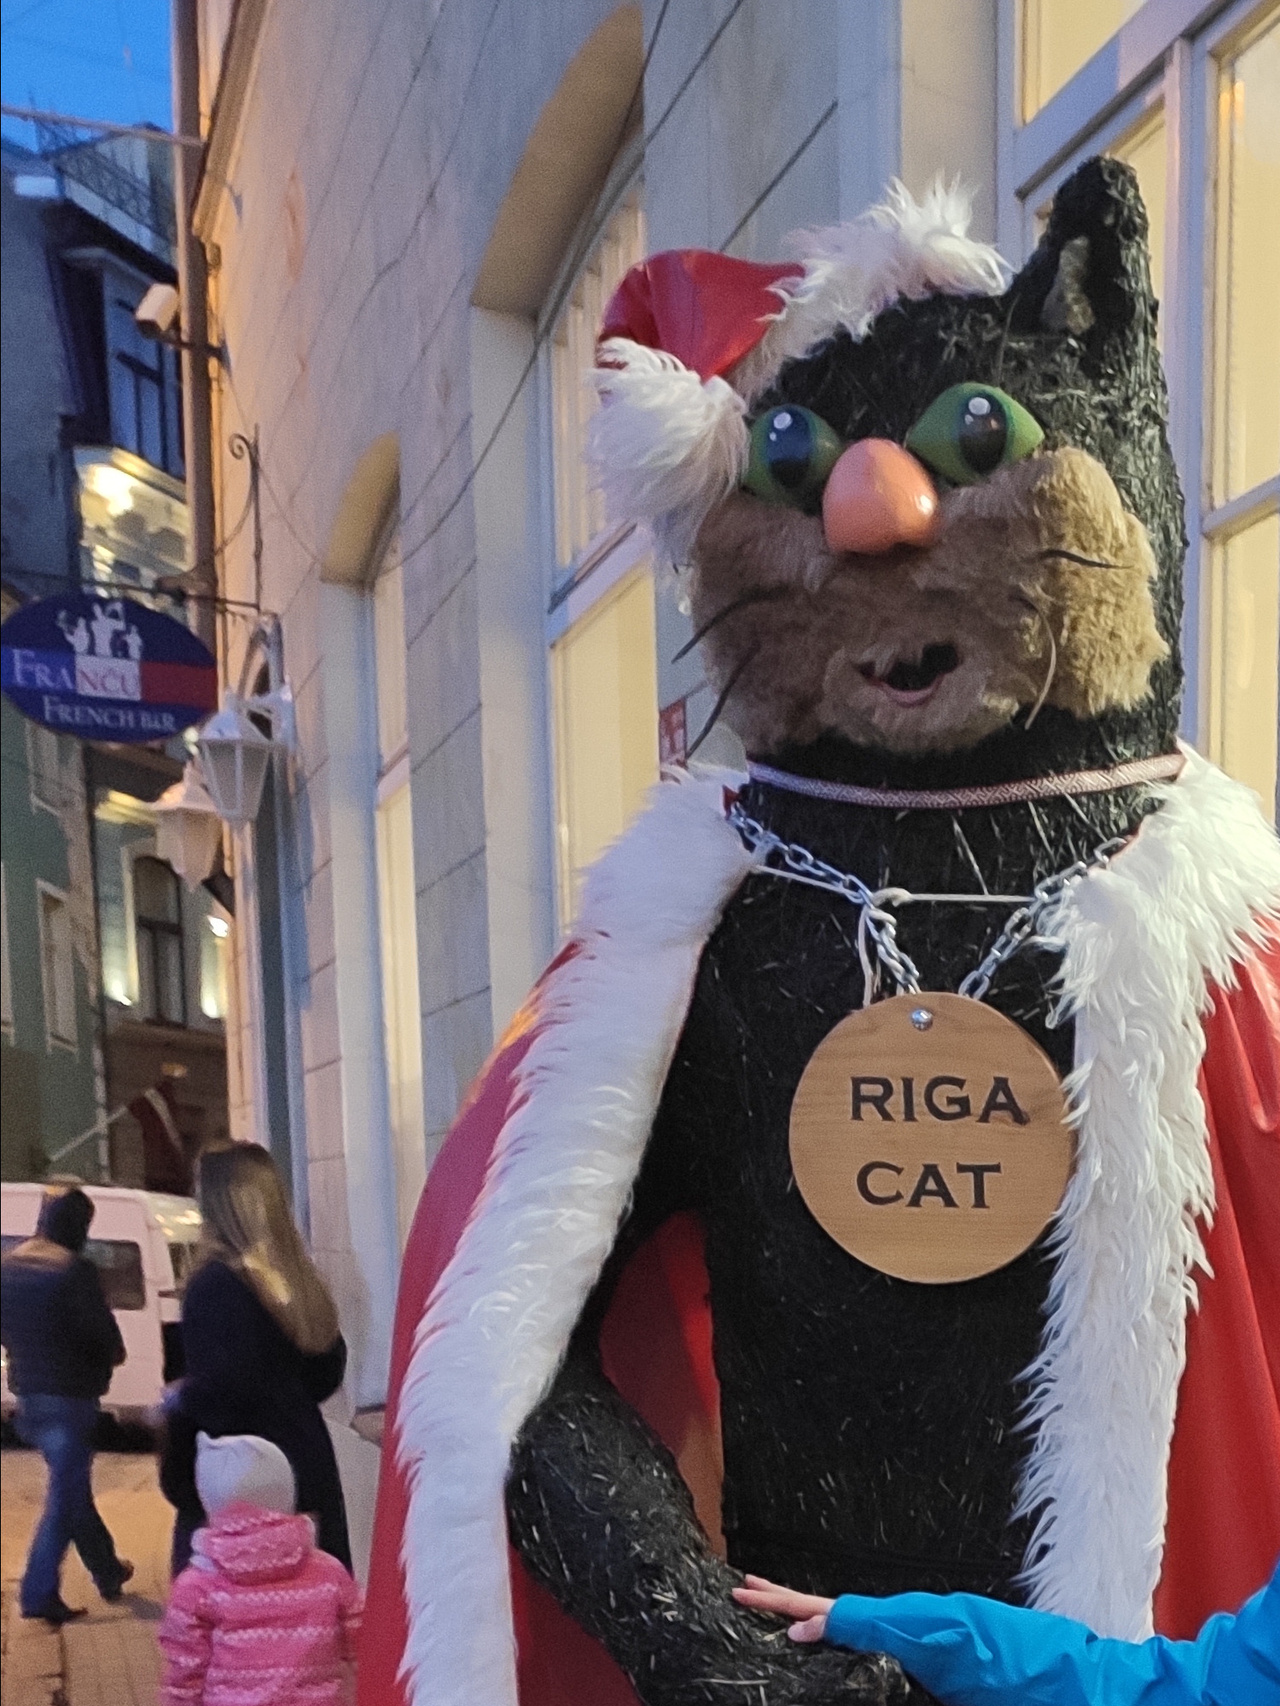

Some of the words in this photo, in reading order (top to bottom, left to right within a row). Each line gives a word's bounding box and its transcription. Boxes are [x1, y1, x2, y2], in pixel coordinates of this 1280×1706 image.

[43, 694, 135, 727] FRENCH
[140, 711, 177, 731] BAR
[850, 1076, 1031, 1125] RIGA
[856, 1161, 1003, 1209] CAT
